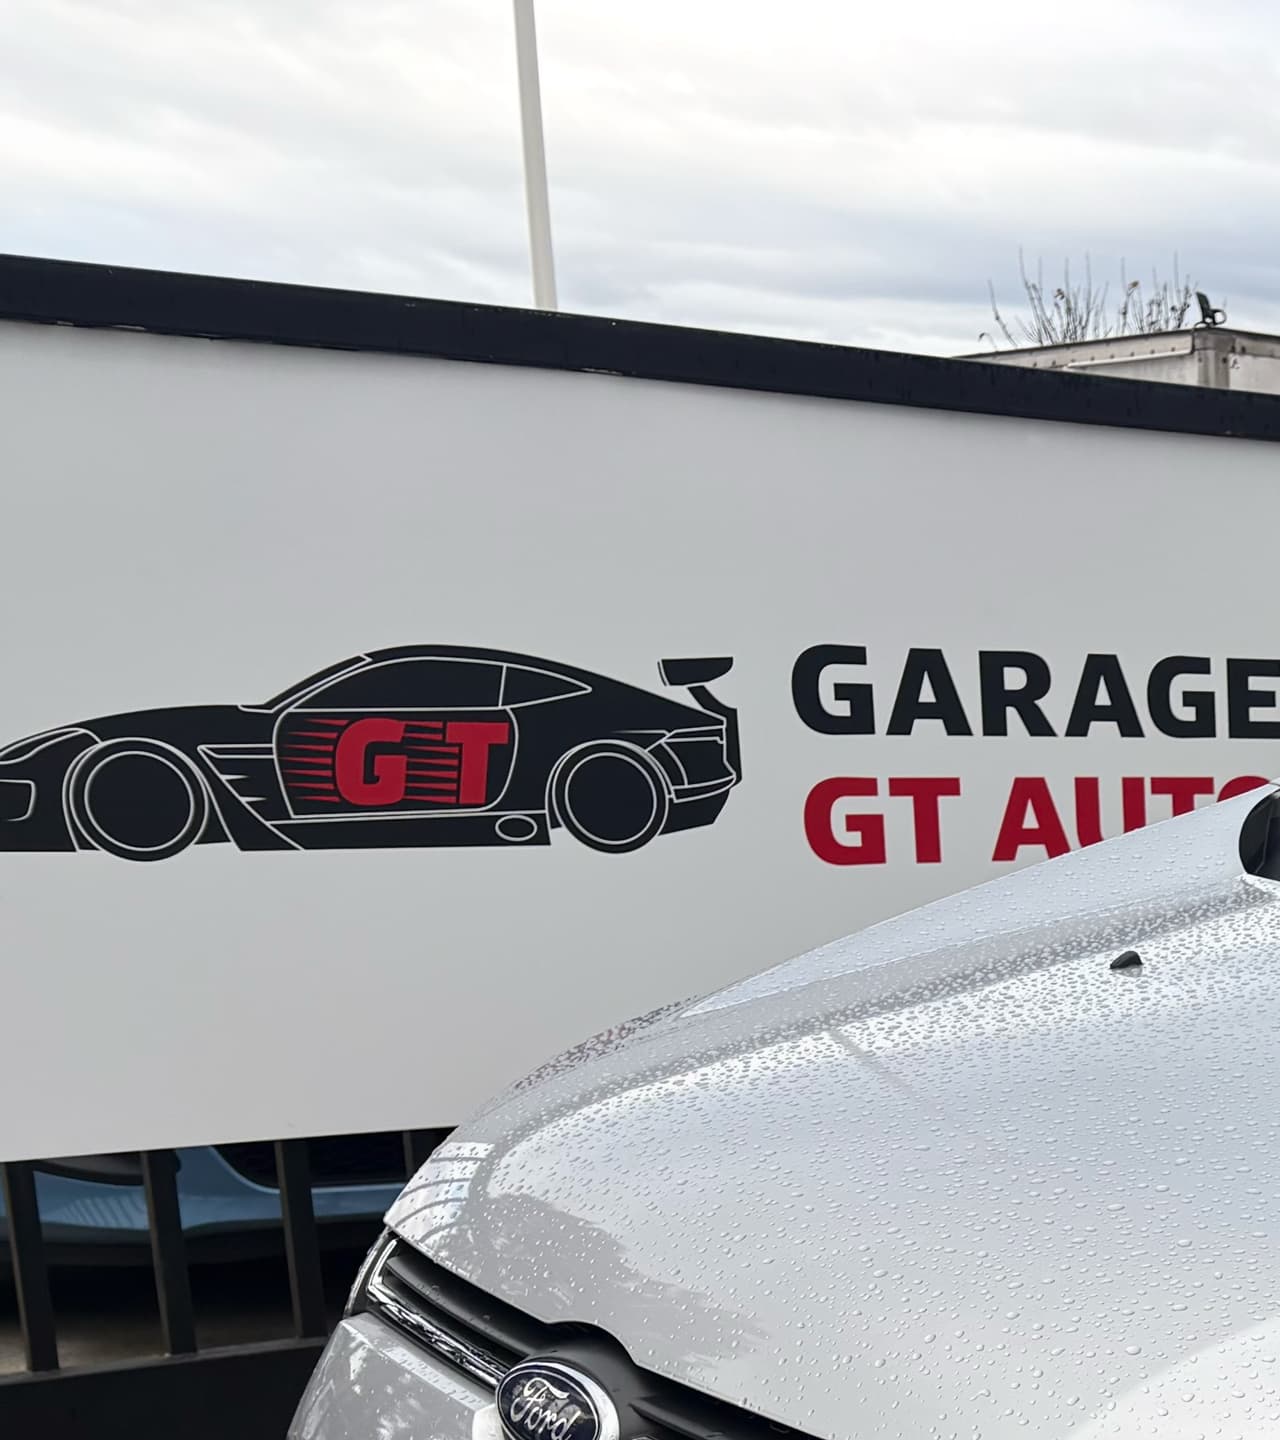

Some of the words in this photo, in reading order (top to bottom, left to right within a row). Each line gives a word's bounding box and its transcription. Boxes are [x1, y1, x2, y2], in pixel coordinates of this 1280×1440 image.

[335, 718, 509, 806] GT
[804, 776, 961, 866] GT
[992, 775, 1273, 862] AUT
